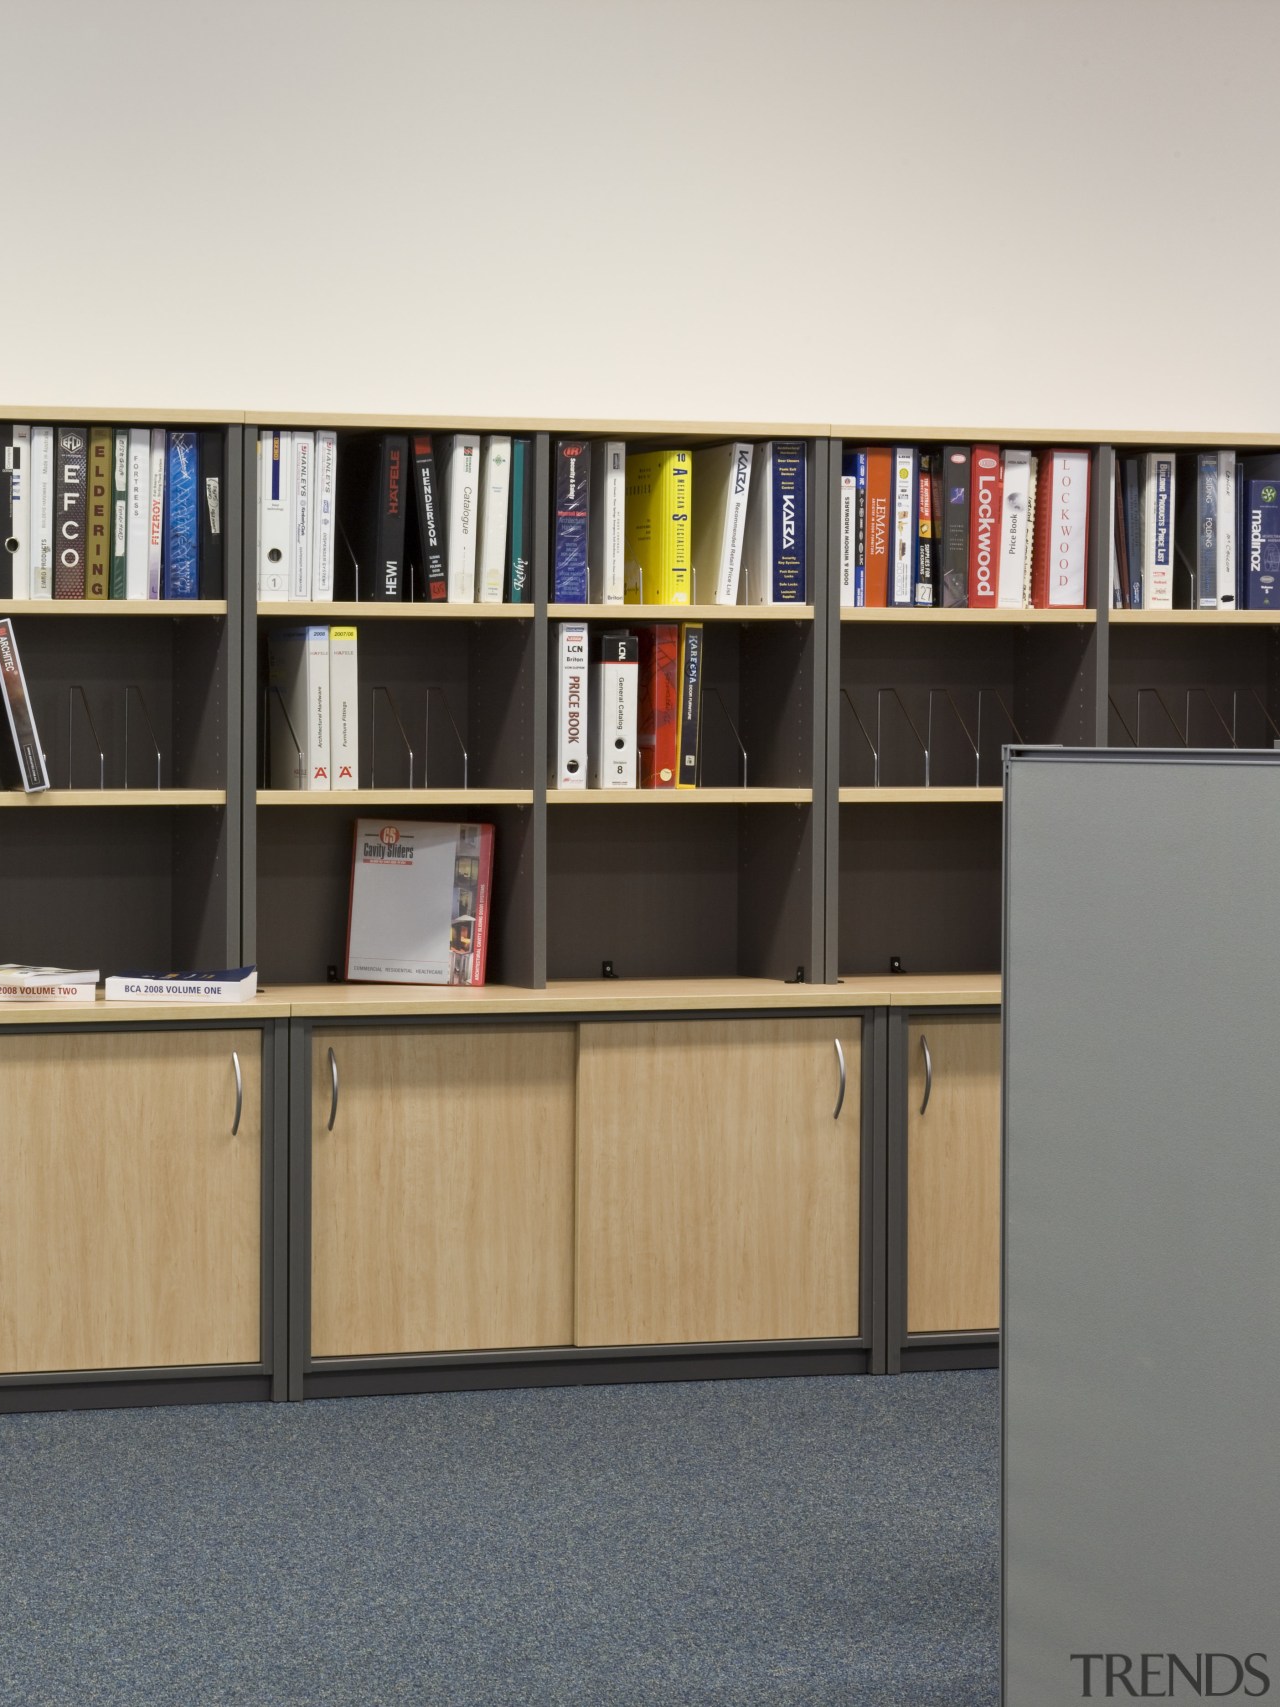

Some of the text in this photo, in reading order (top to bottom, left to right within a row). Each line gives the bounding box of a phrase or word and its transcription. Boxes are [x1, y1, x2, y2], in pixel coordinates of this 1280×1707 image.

[676, 453, 686, 462] 10
[735, 450, 749, 494] KABA
[61, 464, 81, 568] EFCO
[91, 446, 105, 595] ELDERING
[421, 468, 437, 546] HENDERSON
[462, 486, 472, 535] Catalogue
[731, 502, 740, 547] Recommended
[783, 495, 795, 549] KABA
[876, 498, 886, 555] LEMAAR
[1010, 514, 1018, 533] Book
[1059, 459, 1072, 587] LOCKWOOD
[977, 476, 996, 596] Lockwood
[1251, 510, 1266, 572] madinoz
[386, 560, 397, 595] HEWI
[513, 557, 528, 591] Kethy
[921, 585, 932, 601] 27
[0, 637, 15, 671] ARCHITEC
[568, 676, 580, 744] PRICE BOOK
[617, 766, 623, 774] 8
[364, 843, 414, 859] Cavity Sliders
[383, 828, 396, 844] CS
[19, 986, 57, 995] VOLUME
[58, 986, 78, 995] TWO
[124, 985, 222, 995] BCA 2008 VOLUME ONE
